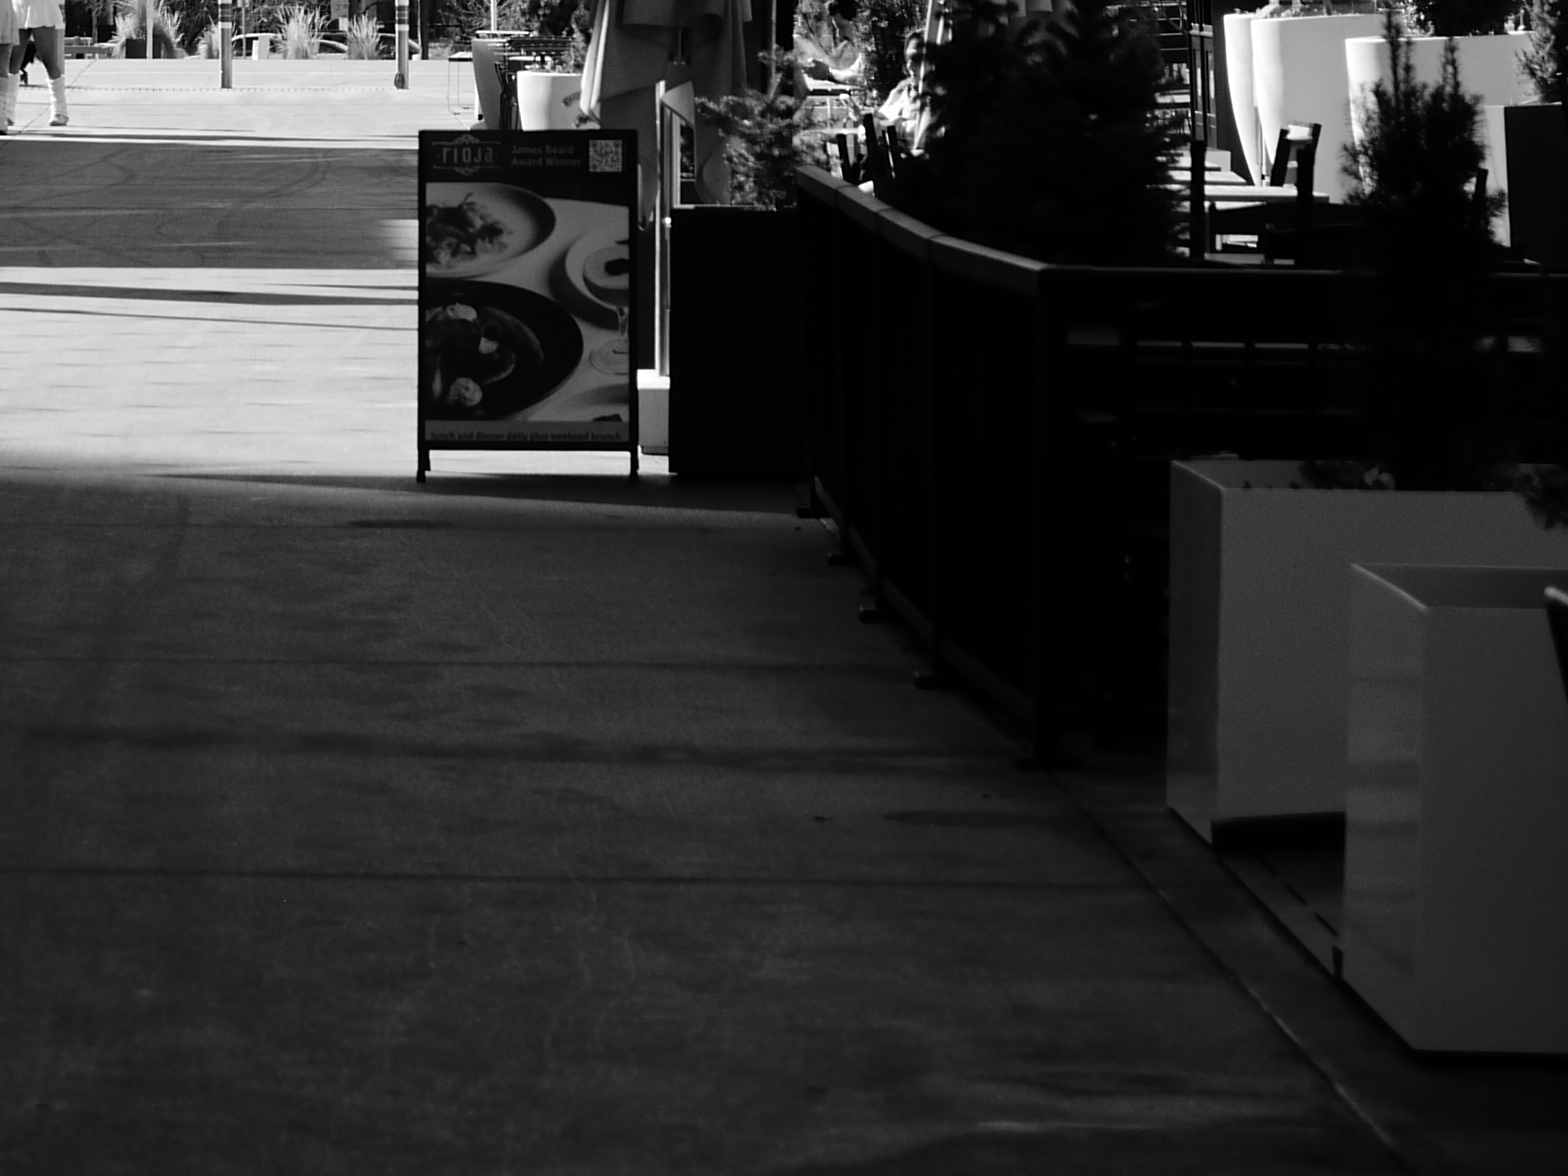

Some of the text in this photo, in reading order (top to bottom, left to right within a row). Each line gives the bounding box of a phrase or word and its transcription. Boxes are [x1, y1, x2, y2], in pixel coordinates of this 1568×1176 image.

[511, 145, 575, 154] James Beard
[511, 157, 582, 166] Award Winner
[431, 431, 622, 442] lunch and dinner daily plus weekend brunch
